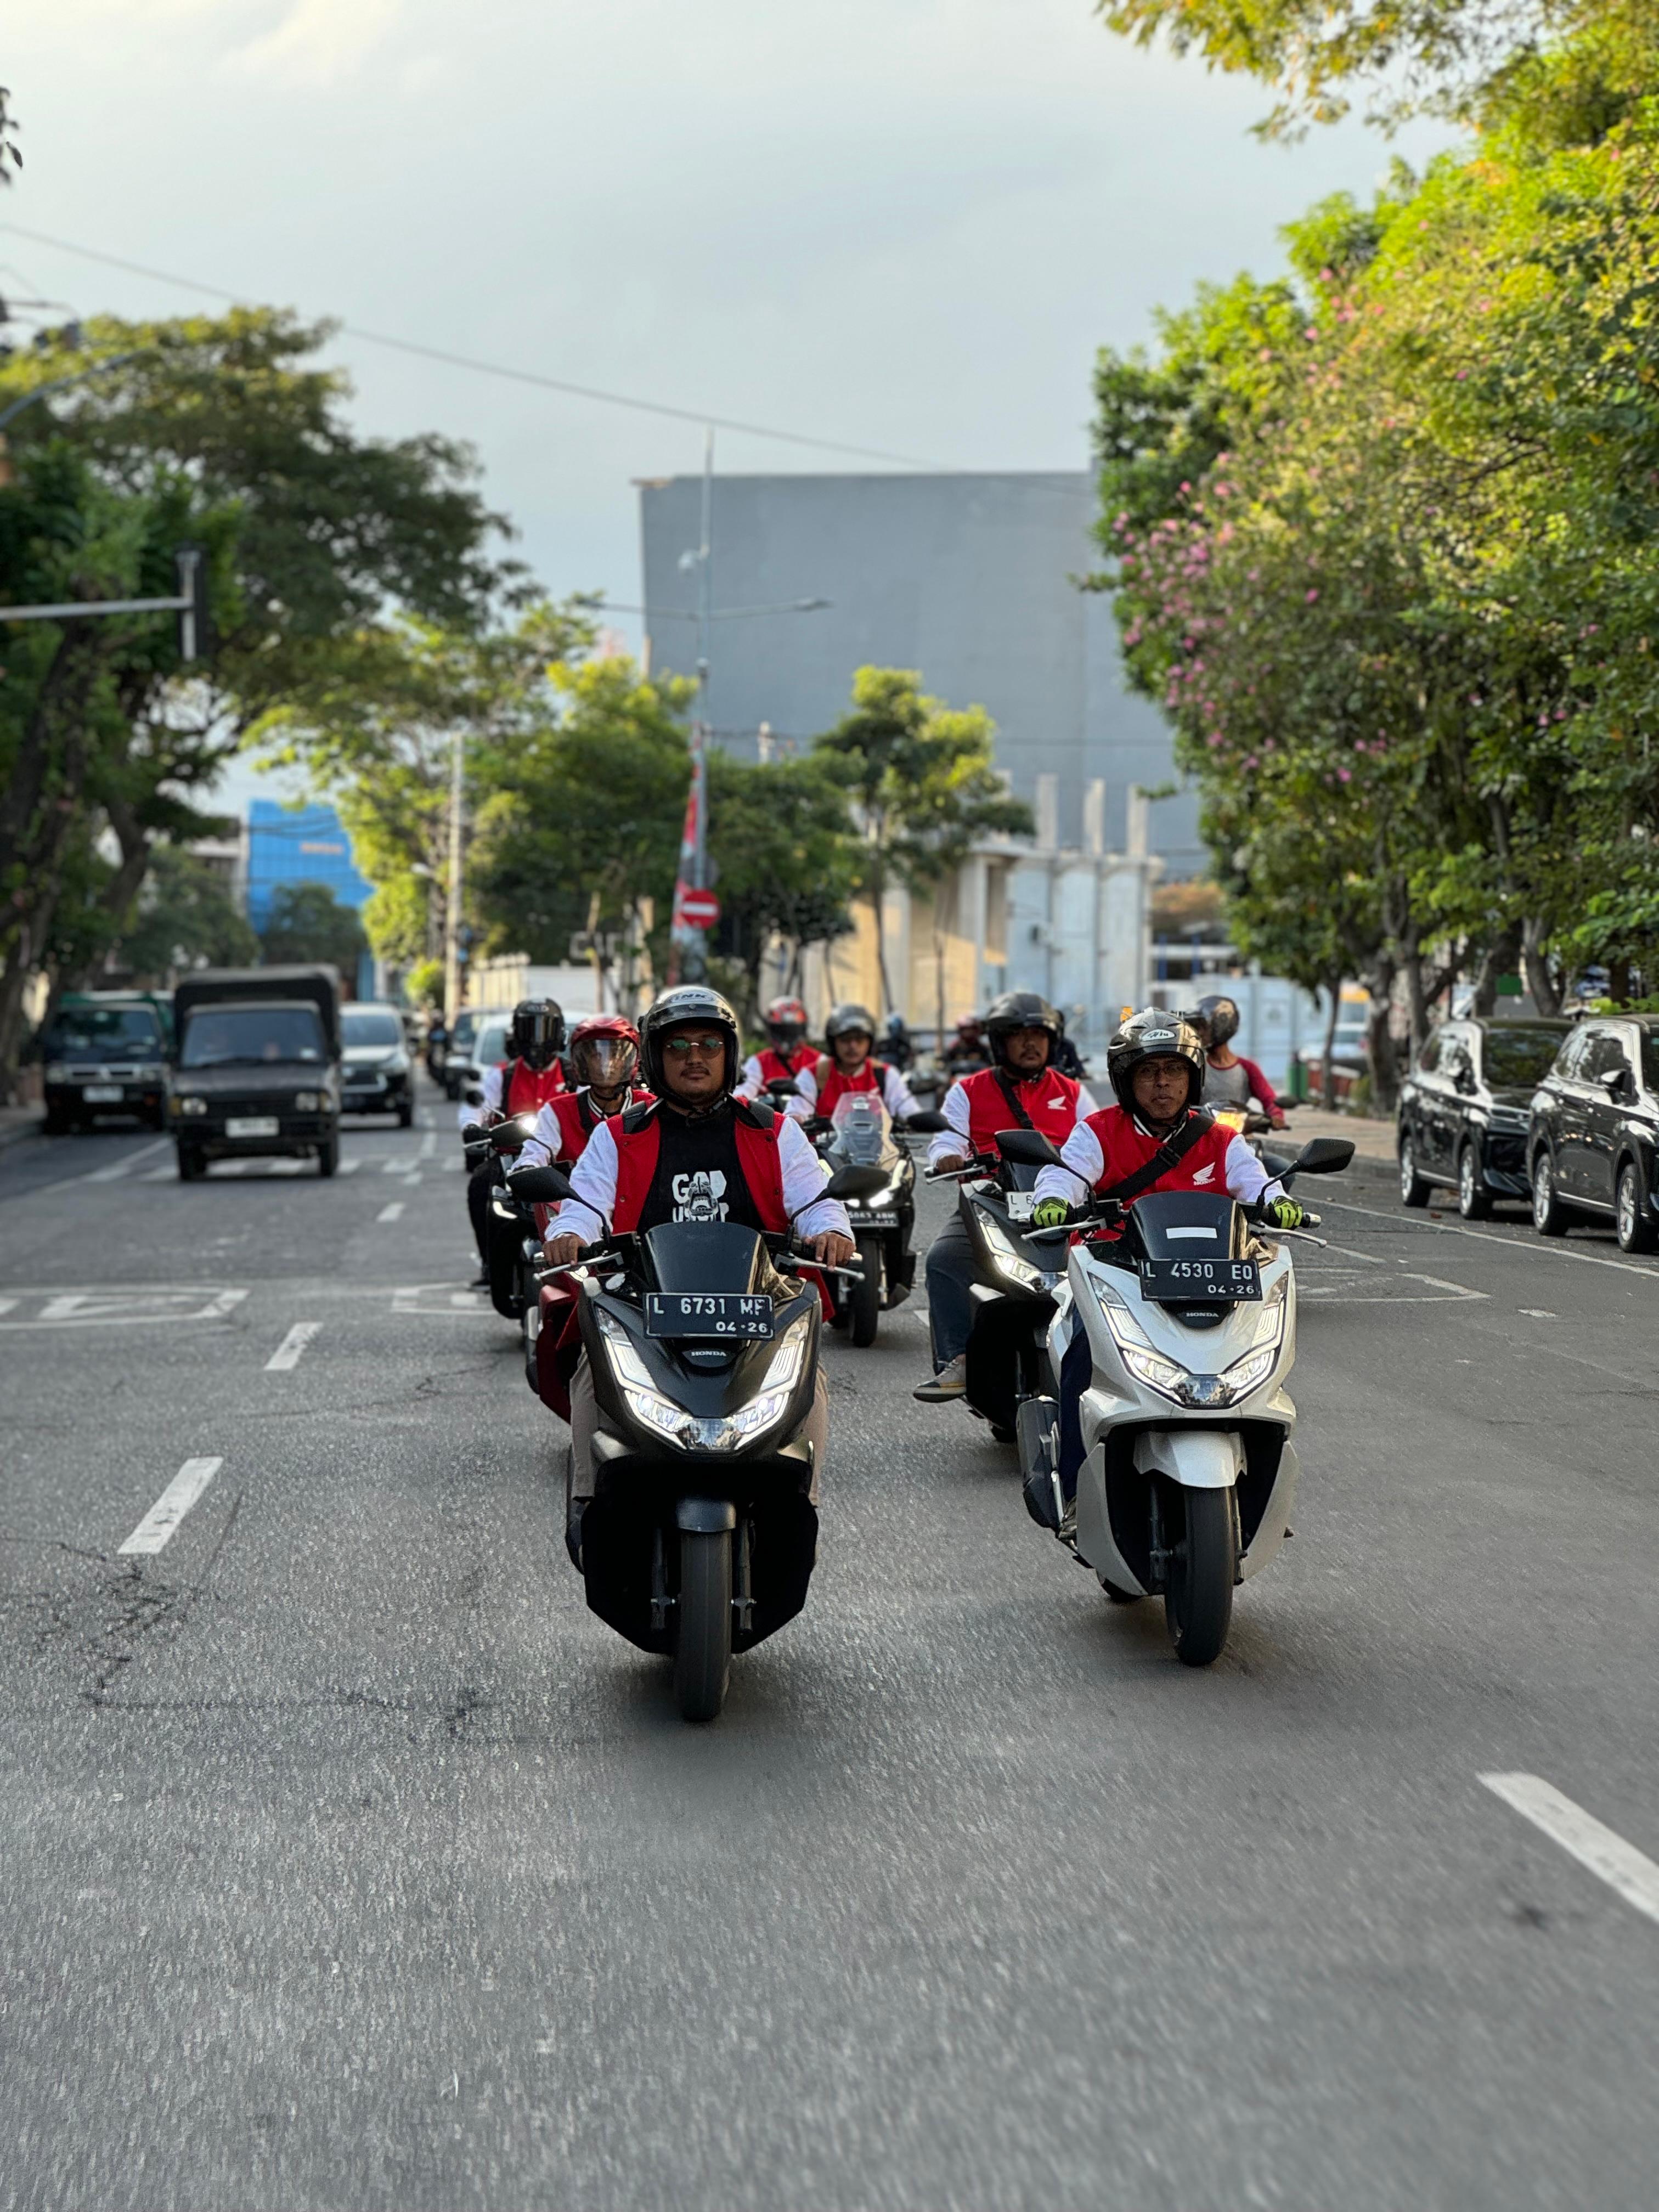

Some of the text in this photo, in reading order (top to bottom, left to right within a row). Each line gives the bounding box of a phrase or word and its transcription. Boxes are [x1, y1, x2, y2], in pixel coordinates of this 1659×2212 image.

[1011, 1195, 1018, 1205] L
[1145, 1262, 1156, 1278] L
[1170, 1262, 1214, 1278] 4530
[653, 1297, 765, 1316] L 6731 MF
